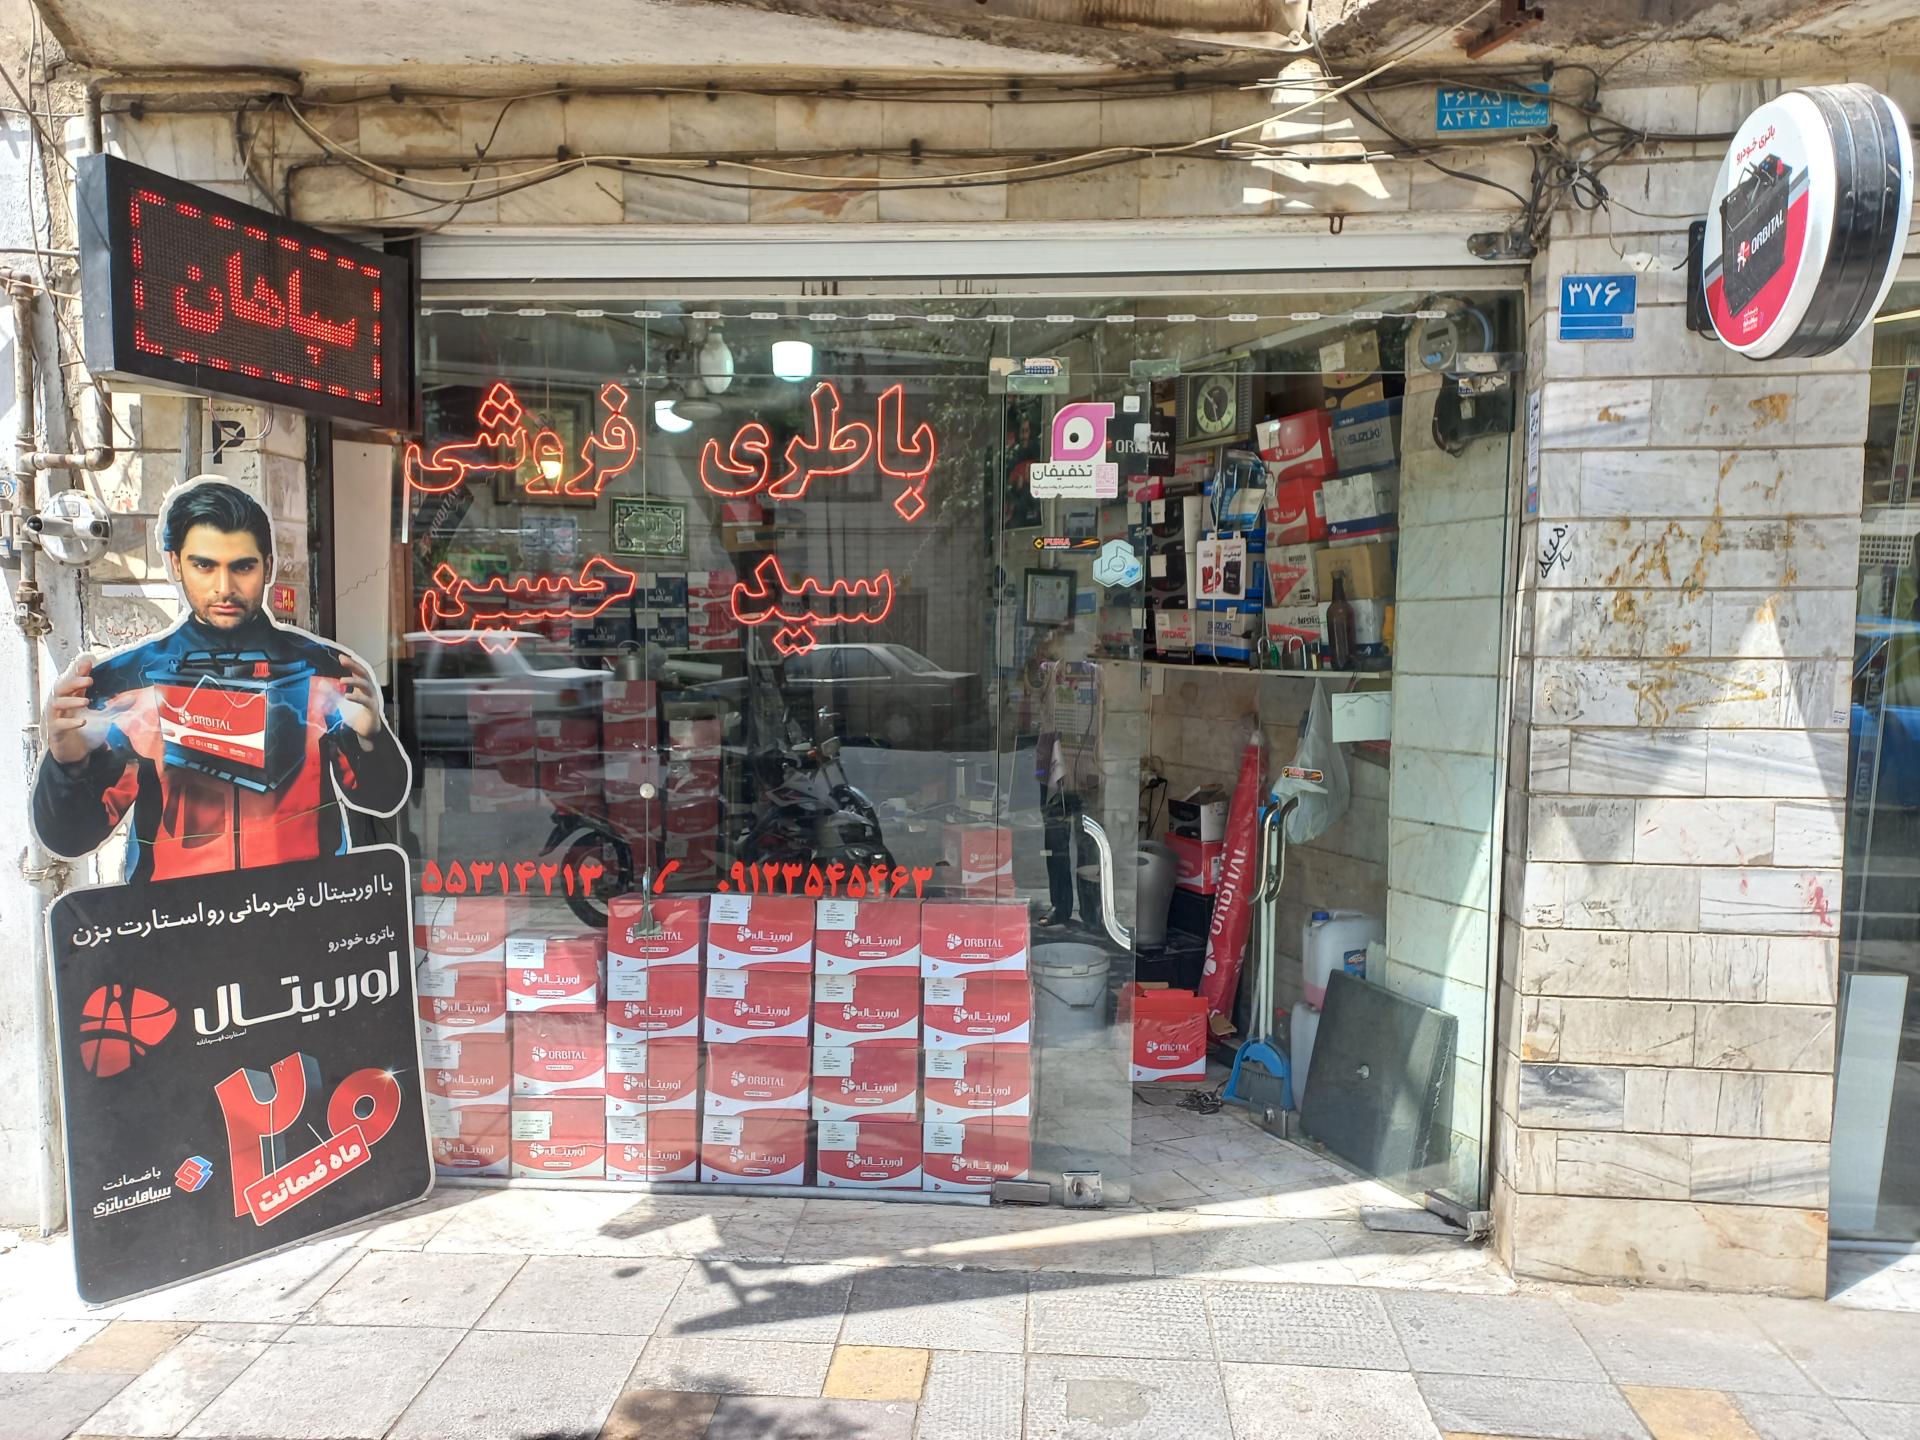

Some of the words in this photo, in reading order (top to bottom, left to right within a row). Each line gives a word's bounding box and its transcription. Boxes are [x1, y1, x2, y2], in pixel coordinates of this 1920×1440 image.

[1751, 208, 1784, 255] ORBITAL
[1567, 281, 1621, 307] ۳۷۶
[174, 250, 359, 368] سپاهان
[404, 382, 639, 497] فروشی
[699, 381, 936, 522] باطری
[1115, 439, 1169, 455] ORTAL
[1032, 464, 1093, 481] تخفیفان
[420, 557, 638, 655] حسین
[730, 553, 894, 658] سید
[192, 714, 233, 731] ORBITAL
[310, 875, 379, 906] اوربیتال
[380, 874, 394, 893] با
[420, 859, 604, 896] ۵۵۳۱۴۲۱۳
[716, 860, 934, 899] ۰۹۱۲۳۵۴۵۴۶۳
[116, 901, 204, 936] استارت
[207, 908, 225, 928] رو
[228, 887, 306, 924] قهرمانی
[72, 924, 112, 948] بزن
[327, 932, 363, 953] خودرو
[364, 924, 395, 947] باتری
[963, 938, 1003, 948] ORBITAL
[193, 950, 400, 1036] اوربیتال
[548, 1050, 587, 1060] ORBITAL
[747, 1077, 785, 1087] ORBITAL
[329, 1141, 362, 1170] ماه
[258, 1157, 329, 1213] ضمانت
